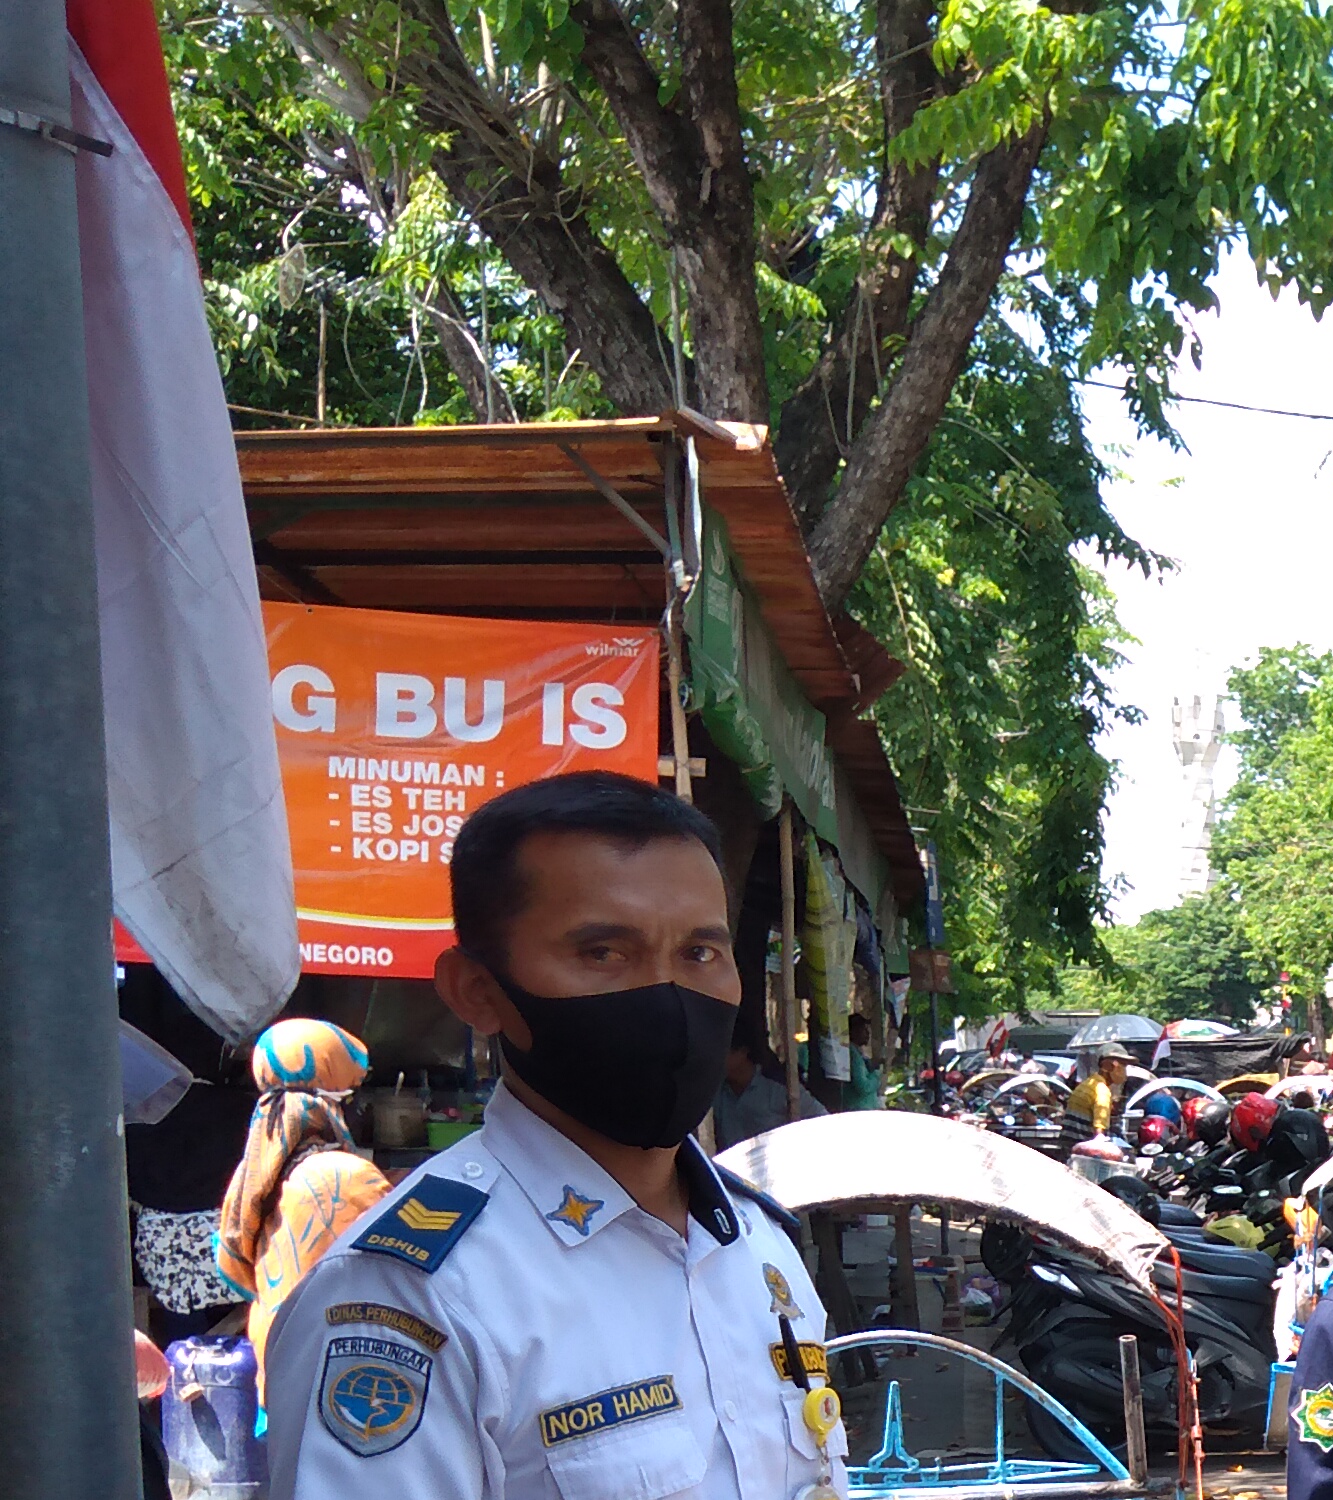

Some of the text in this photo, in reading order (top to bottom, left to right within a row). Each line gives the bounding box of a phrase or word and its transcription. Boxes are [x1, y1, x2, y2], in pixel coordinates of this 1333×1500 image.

[584, 643, 640, 657] wilmar
[375, 671, 506, 743] BU
[541, 681, 628, 750] IS
[327, 756, 486, 787] MINUMAN
[351, 784, 393, 809] ES
[402, 788, 466, 812] TEH
[352, 811, 394, 835] ES
[402, 814, 464, 838] JOS
[353, 837, 430, 863] KOPI
[366, 1233, 431, 1262] DISHUB
[333, 1306, 443, 1349] DINAS PERHUBUNGAN
[334, 1340, 427, 1371] PERHUBUNGAN
[548, 1383, 675, 1439] NOR HAMID
